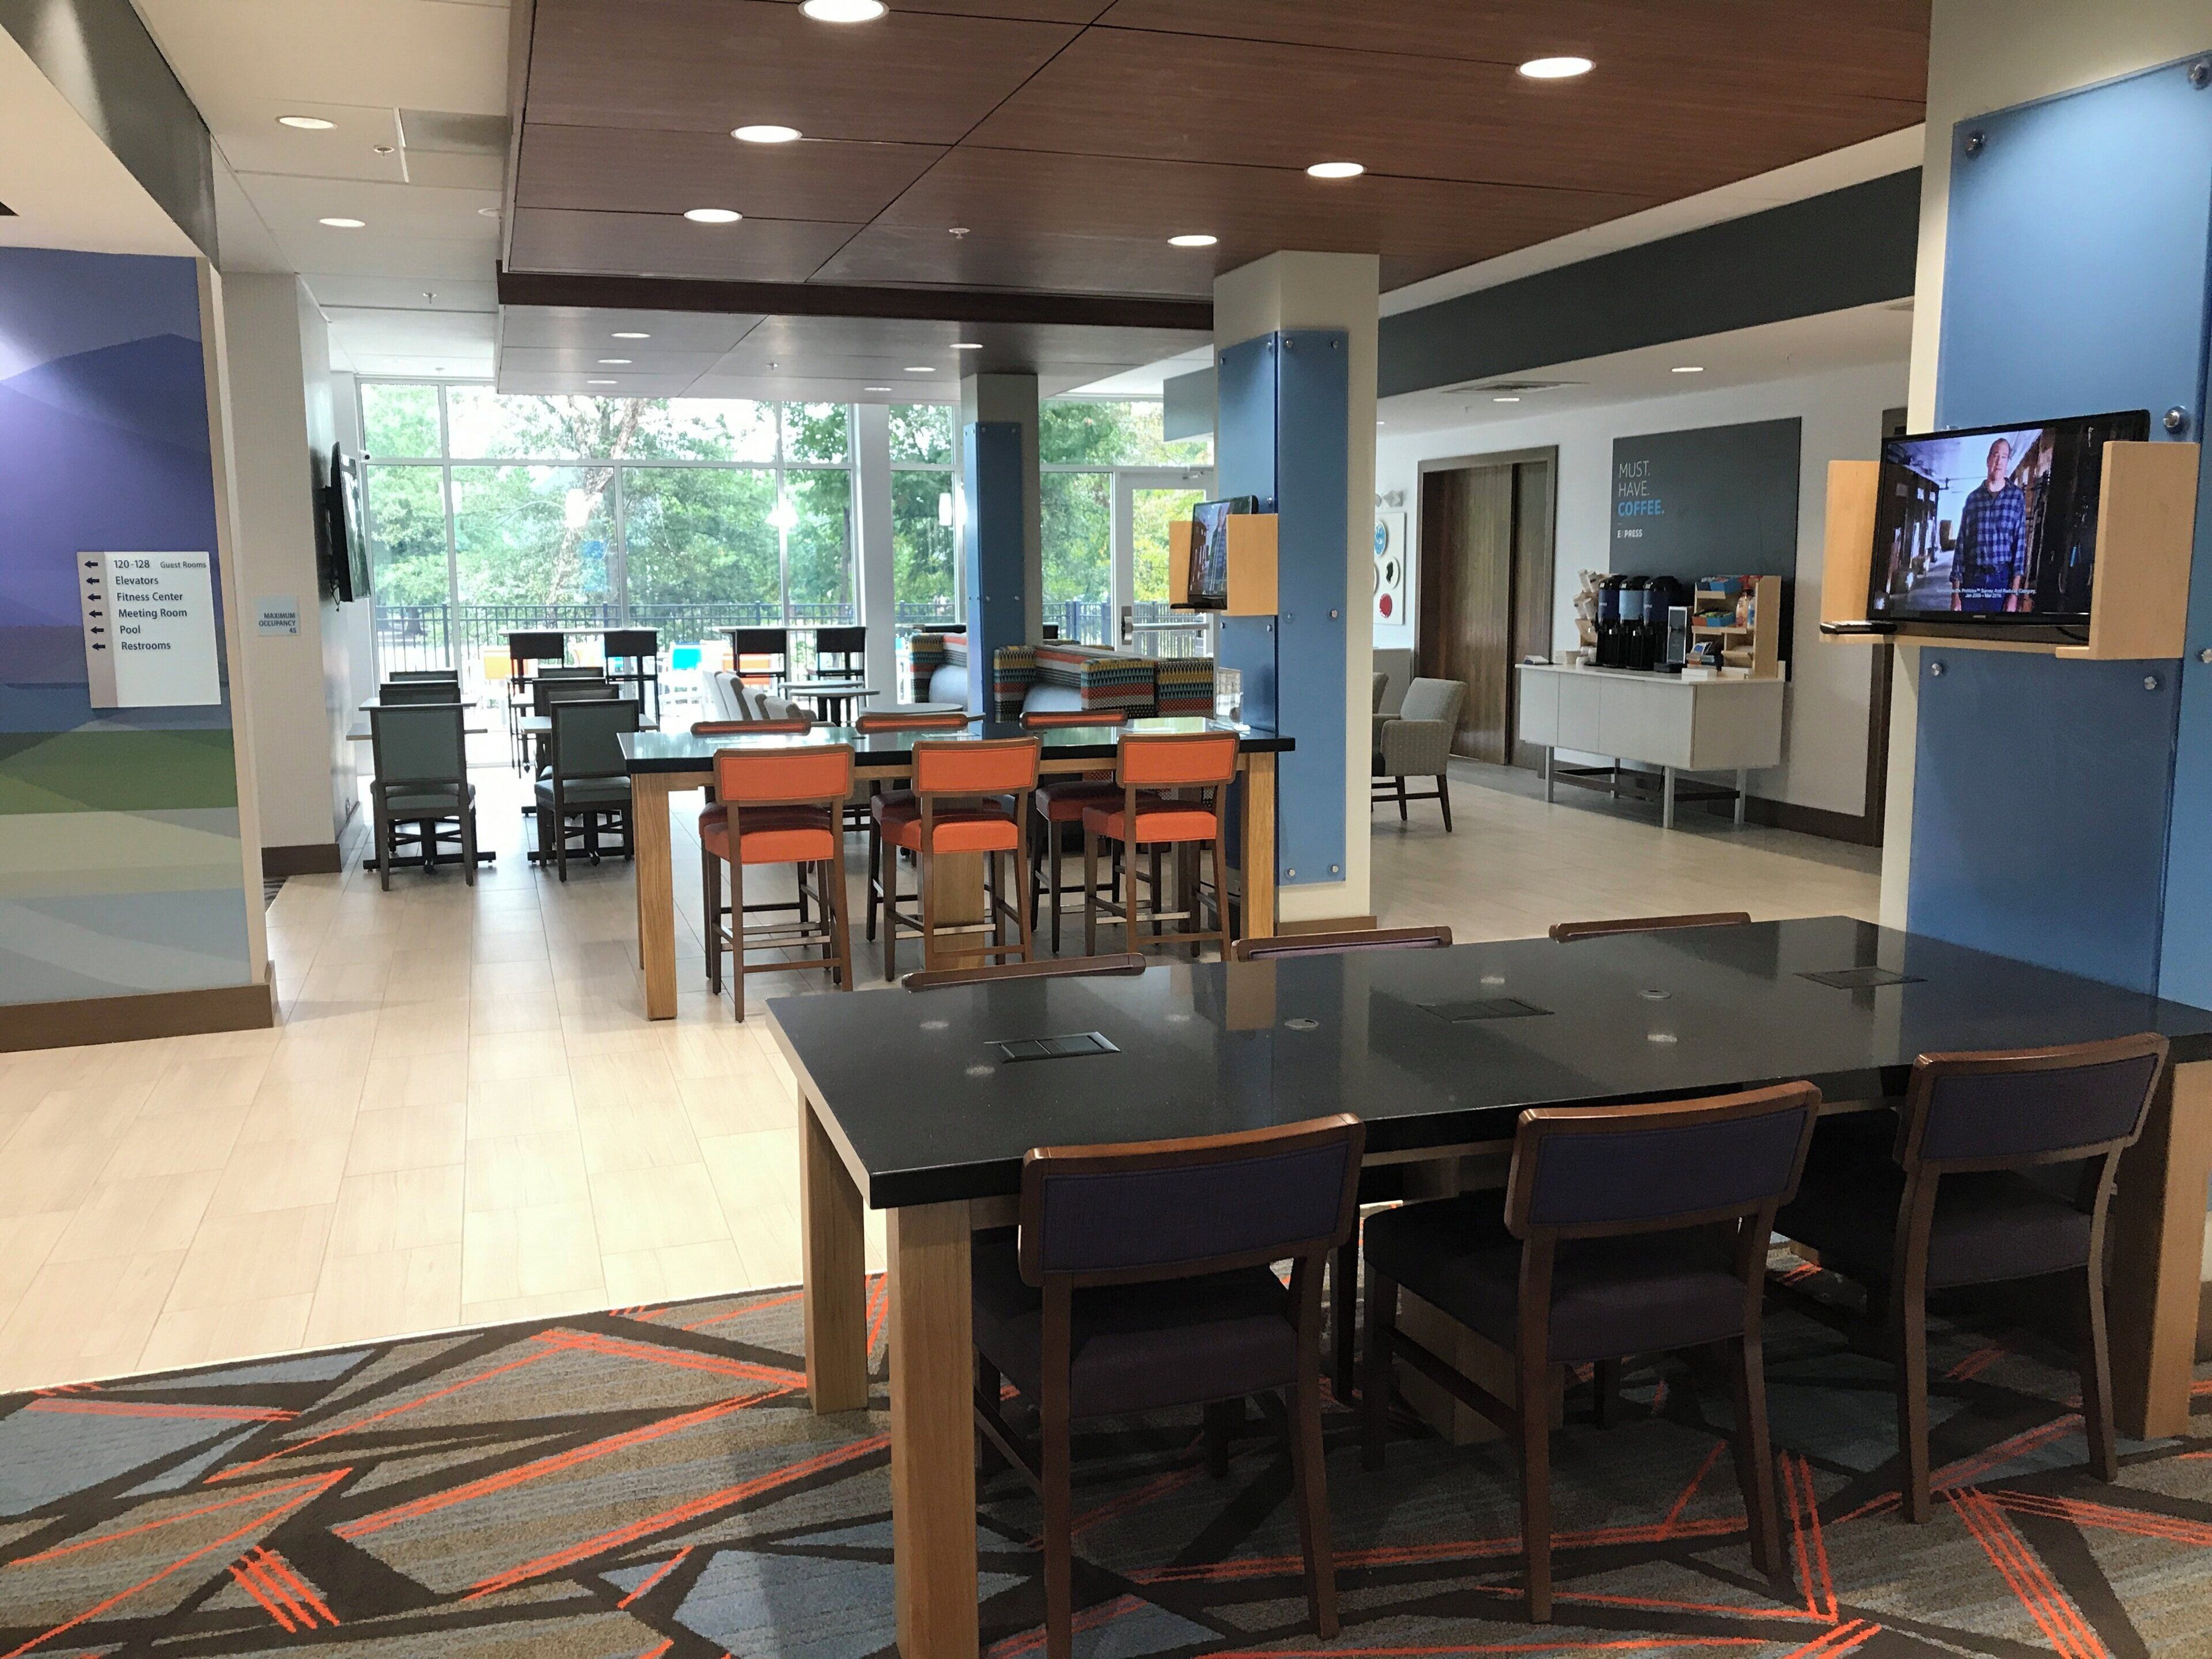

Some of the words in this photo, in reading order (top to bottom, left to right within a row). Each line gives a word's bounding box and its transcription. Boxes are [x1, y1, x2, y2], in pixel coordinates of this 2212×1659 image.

[1619, 461, 1650, 478] MUST.
[1619, 480, 1650, 497] HAVE.
[1618, 499, 1664, 517] COFFEE.
[1617, 529, 1643, 539] EPRESS
[115, 576, 158, 585] Elevators
[117, 592, 149, 601] Fitness
[152, 592, 183, 601] Center
[119, 608, 157, 619] Meeting
[160, 608, 187, 617] Room
[120, 624, 141, 634] Pool
[121, 641, 171, 650] Restrooms
